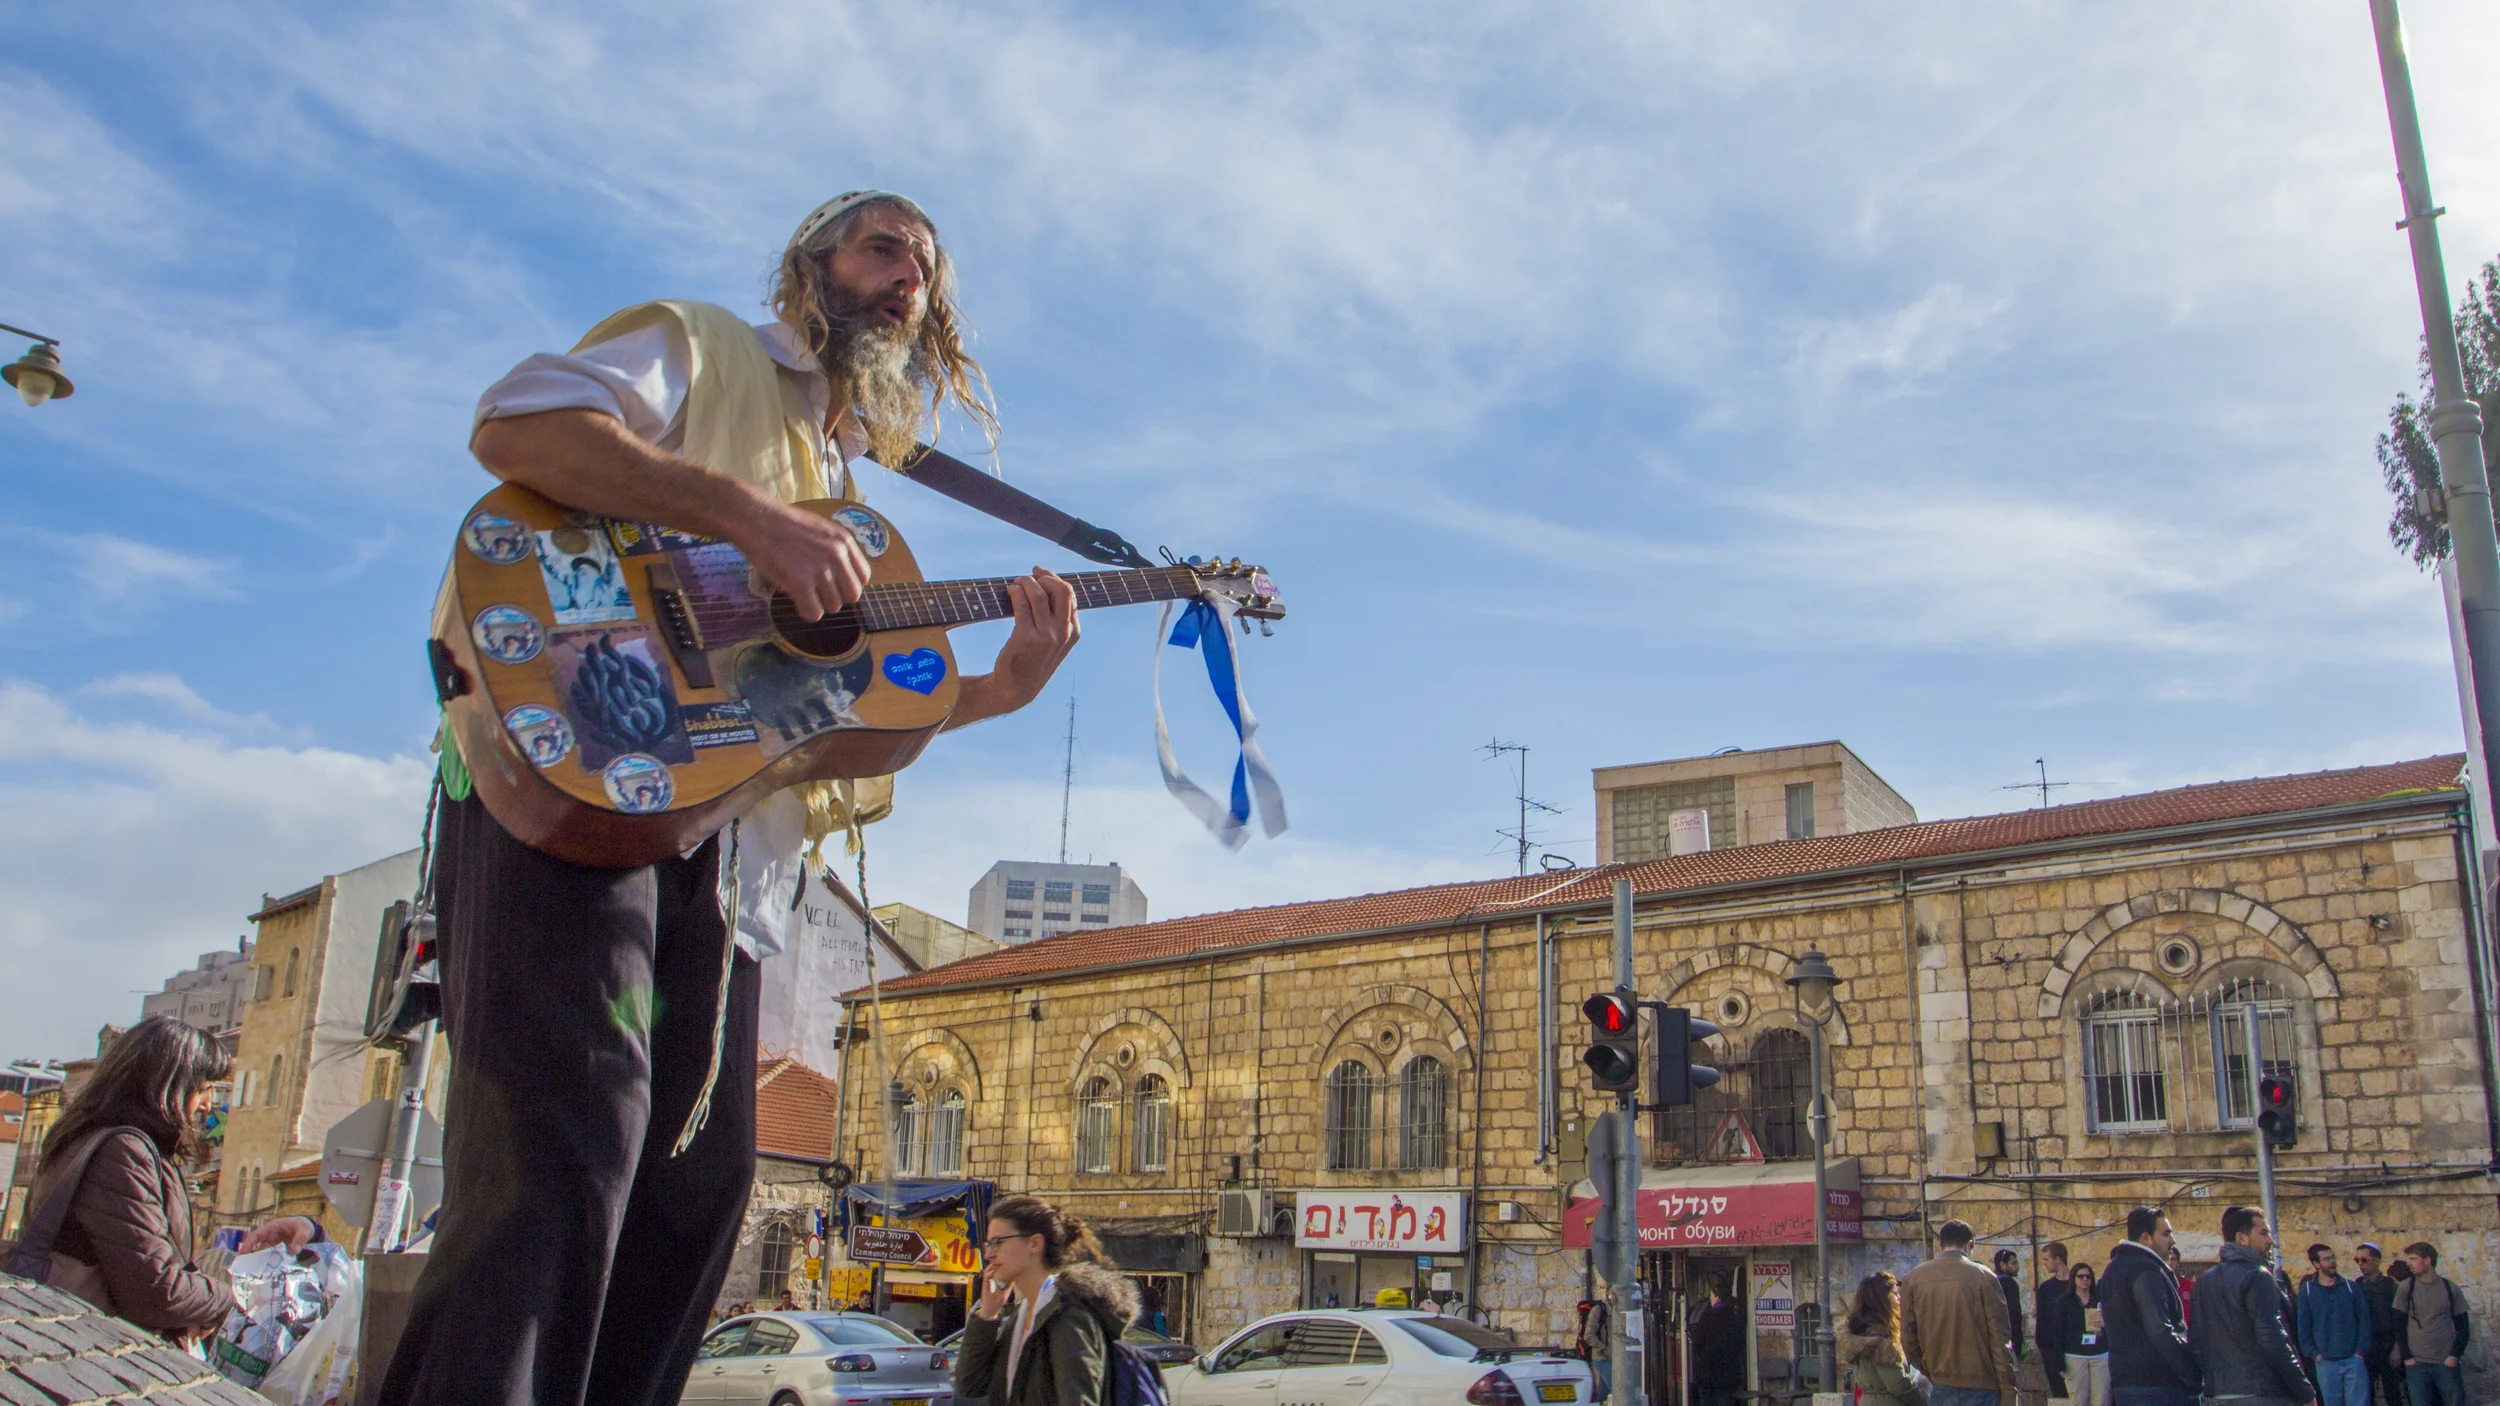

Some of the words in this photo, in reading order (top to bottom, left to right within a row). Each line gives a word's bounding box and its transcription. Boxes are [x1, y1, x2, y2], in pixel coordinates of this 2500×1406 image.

[1658, 1193, 1728, 1217] סנדלר
[1304, 1204, 1446, 1242] גמדים
[1638, 1227, 1677, 1241] монт
[1685, 1220, 1735, 1244] обуви
[858, 1229, 886, 1239] קהילתי
[854, 1248, 889, 1260] Community
[889, 1251, 912, 1261] Council
[947, 1238, 976, 1270] 10
[1754, 1265, 1789, 1276] סנדלר
[1755, 1314, 1793, 1325] SHOEMAKER
